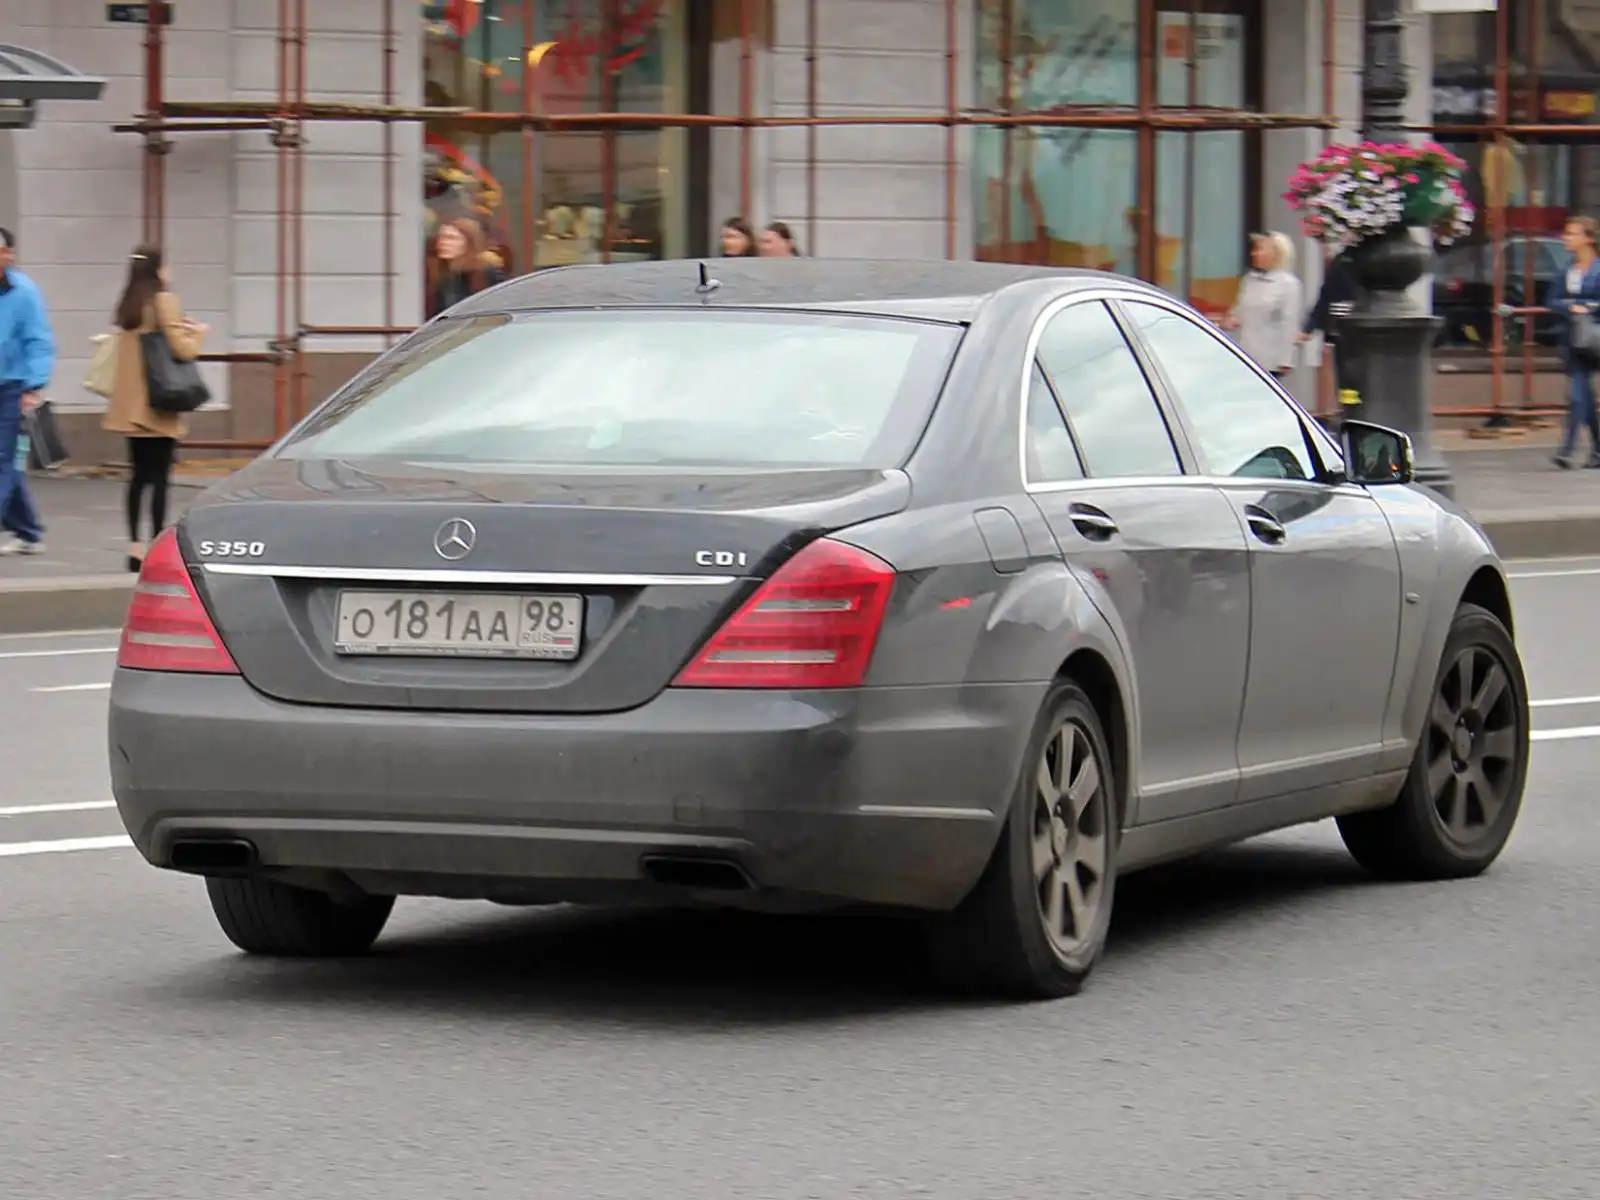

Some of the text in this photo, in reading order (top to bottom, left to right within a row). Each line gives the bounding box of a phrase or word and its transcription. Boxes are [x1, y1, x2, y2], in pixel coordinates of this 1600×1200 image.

[199, 540, 266, 557] S350
[695, 550, 747, 567] CDI
[526, 600, 564, 632] 98
